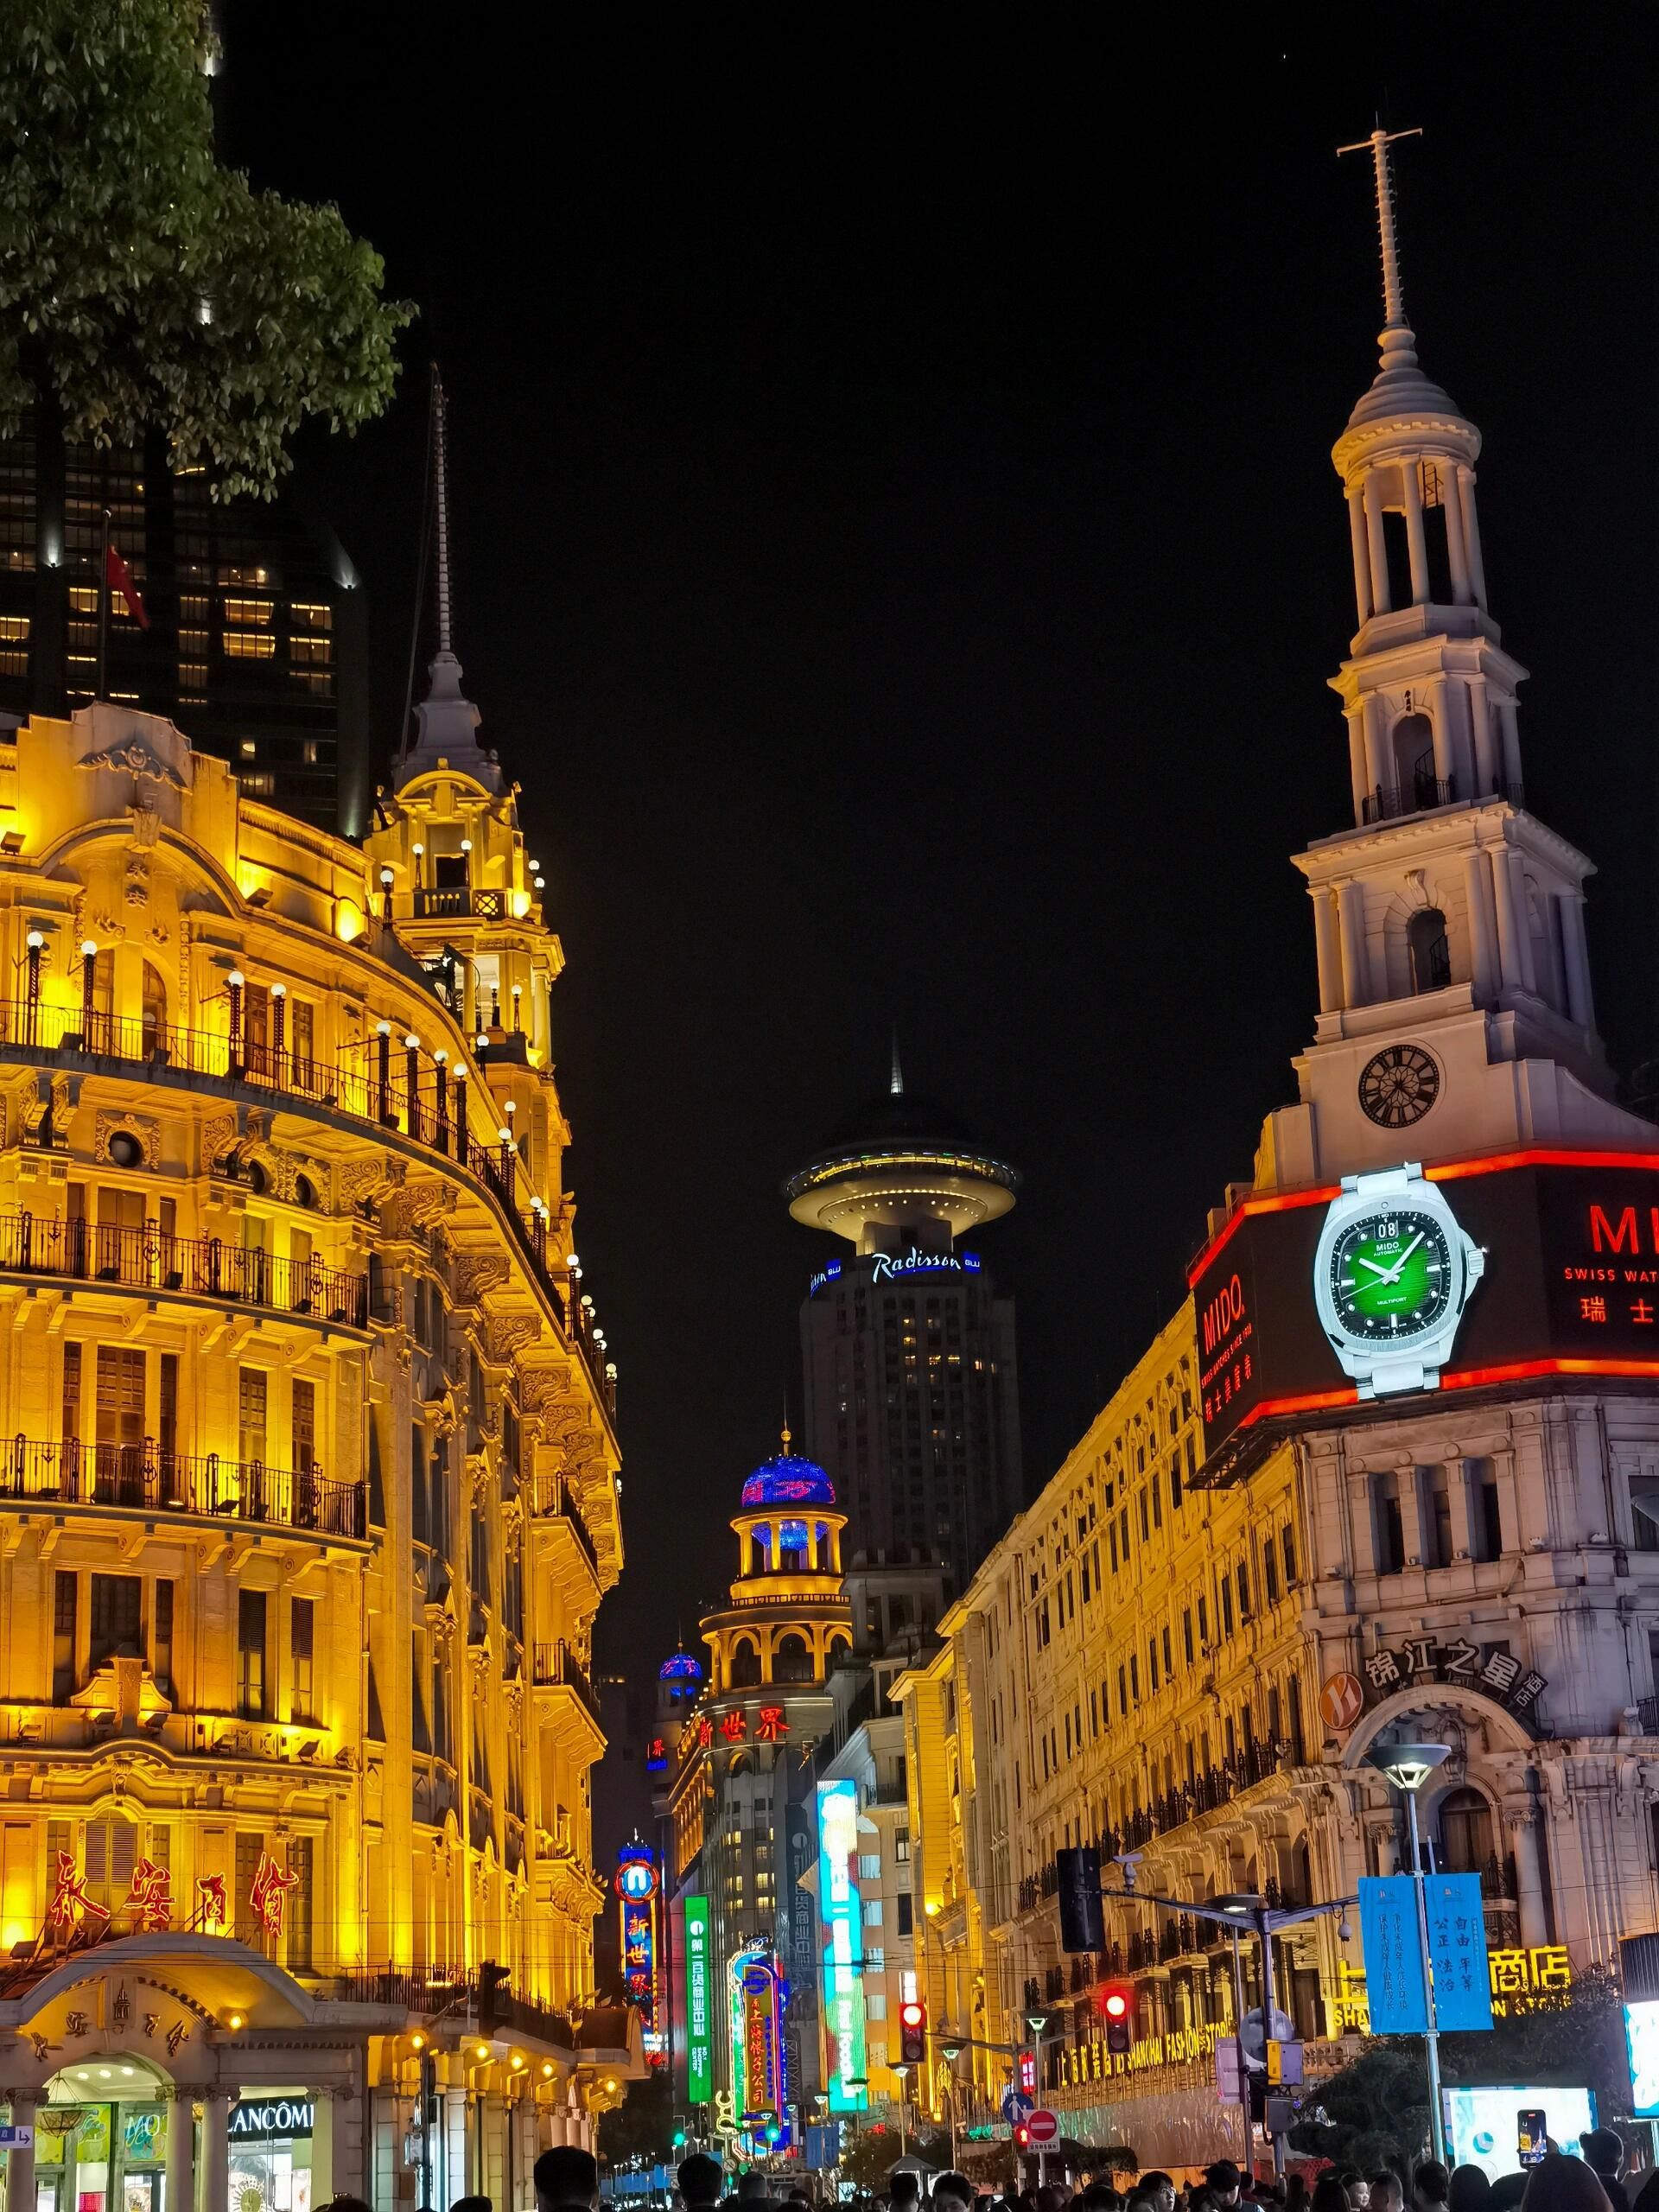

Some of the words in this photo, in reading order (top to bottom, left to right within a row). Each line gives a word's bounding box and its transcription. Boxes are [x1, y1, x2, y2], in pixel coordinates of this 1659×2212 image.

[1376, 1242, 1399, 1251] MIDO
[1378, 1223, 1395, 1238] 08
[872, 1247, 961, 1283] Radisson
[1564, 1268, 1616, 1281] SWISS
[1364, 1641, 1518, 1693] 锦江之星
[700, 1707, 791, 1749] 新世界
[1166, 2027, 1200, 2063] FASHION
